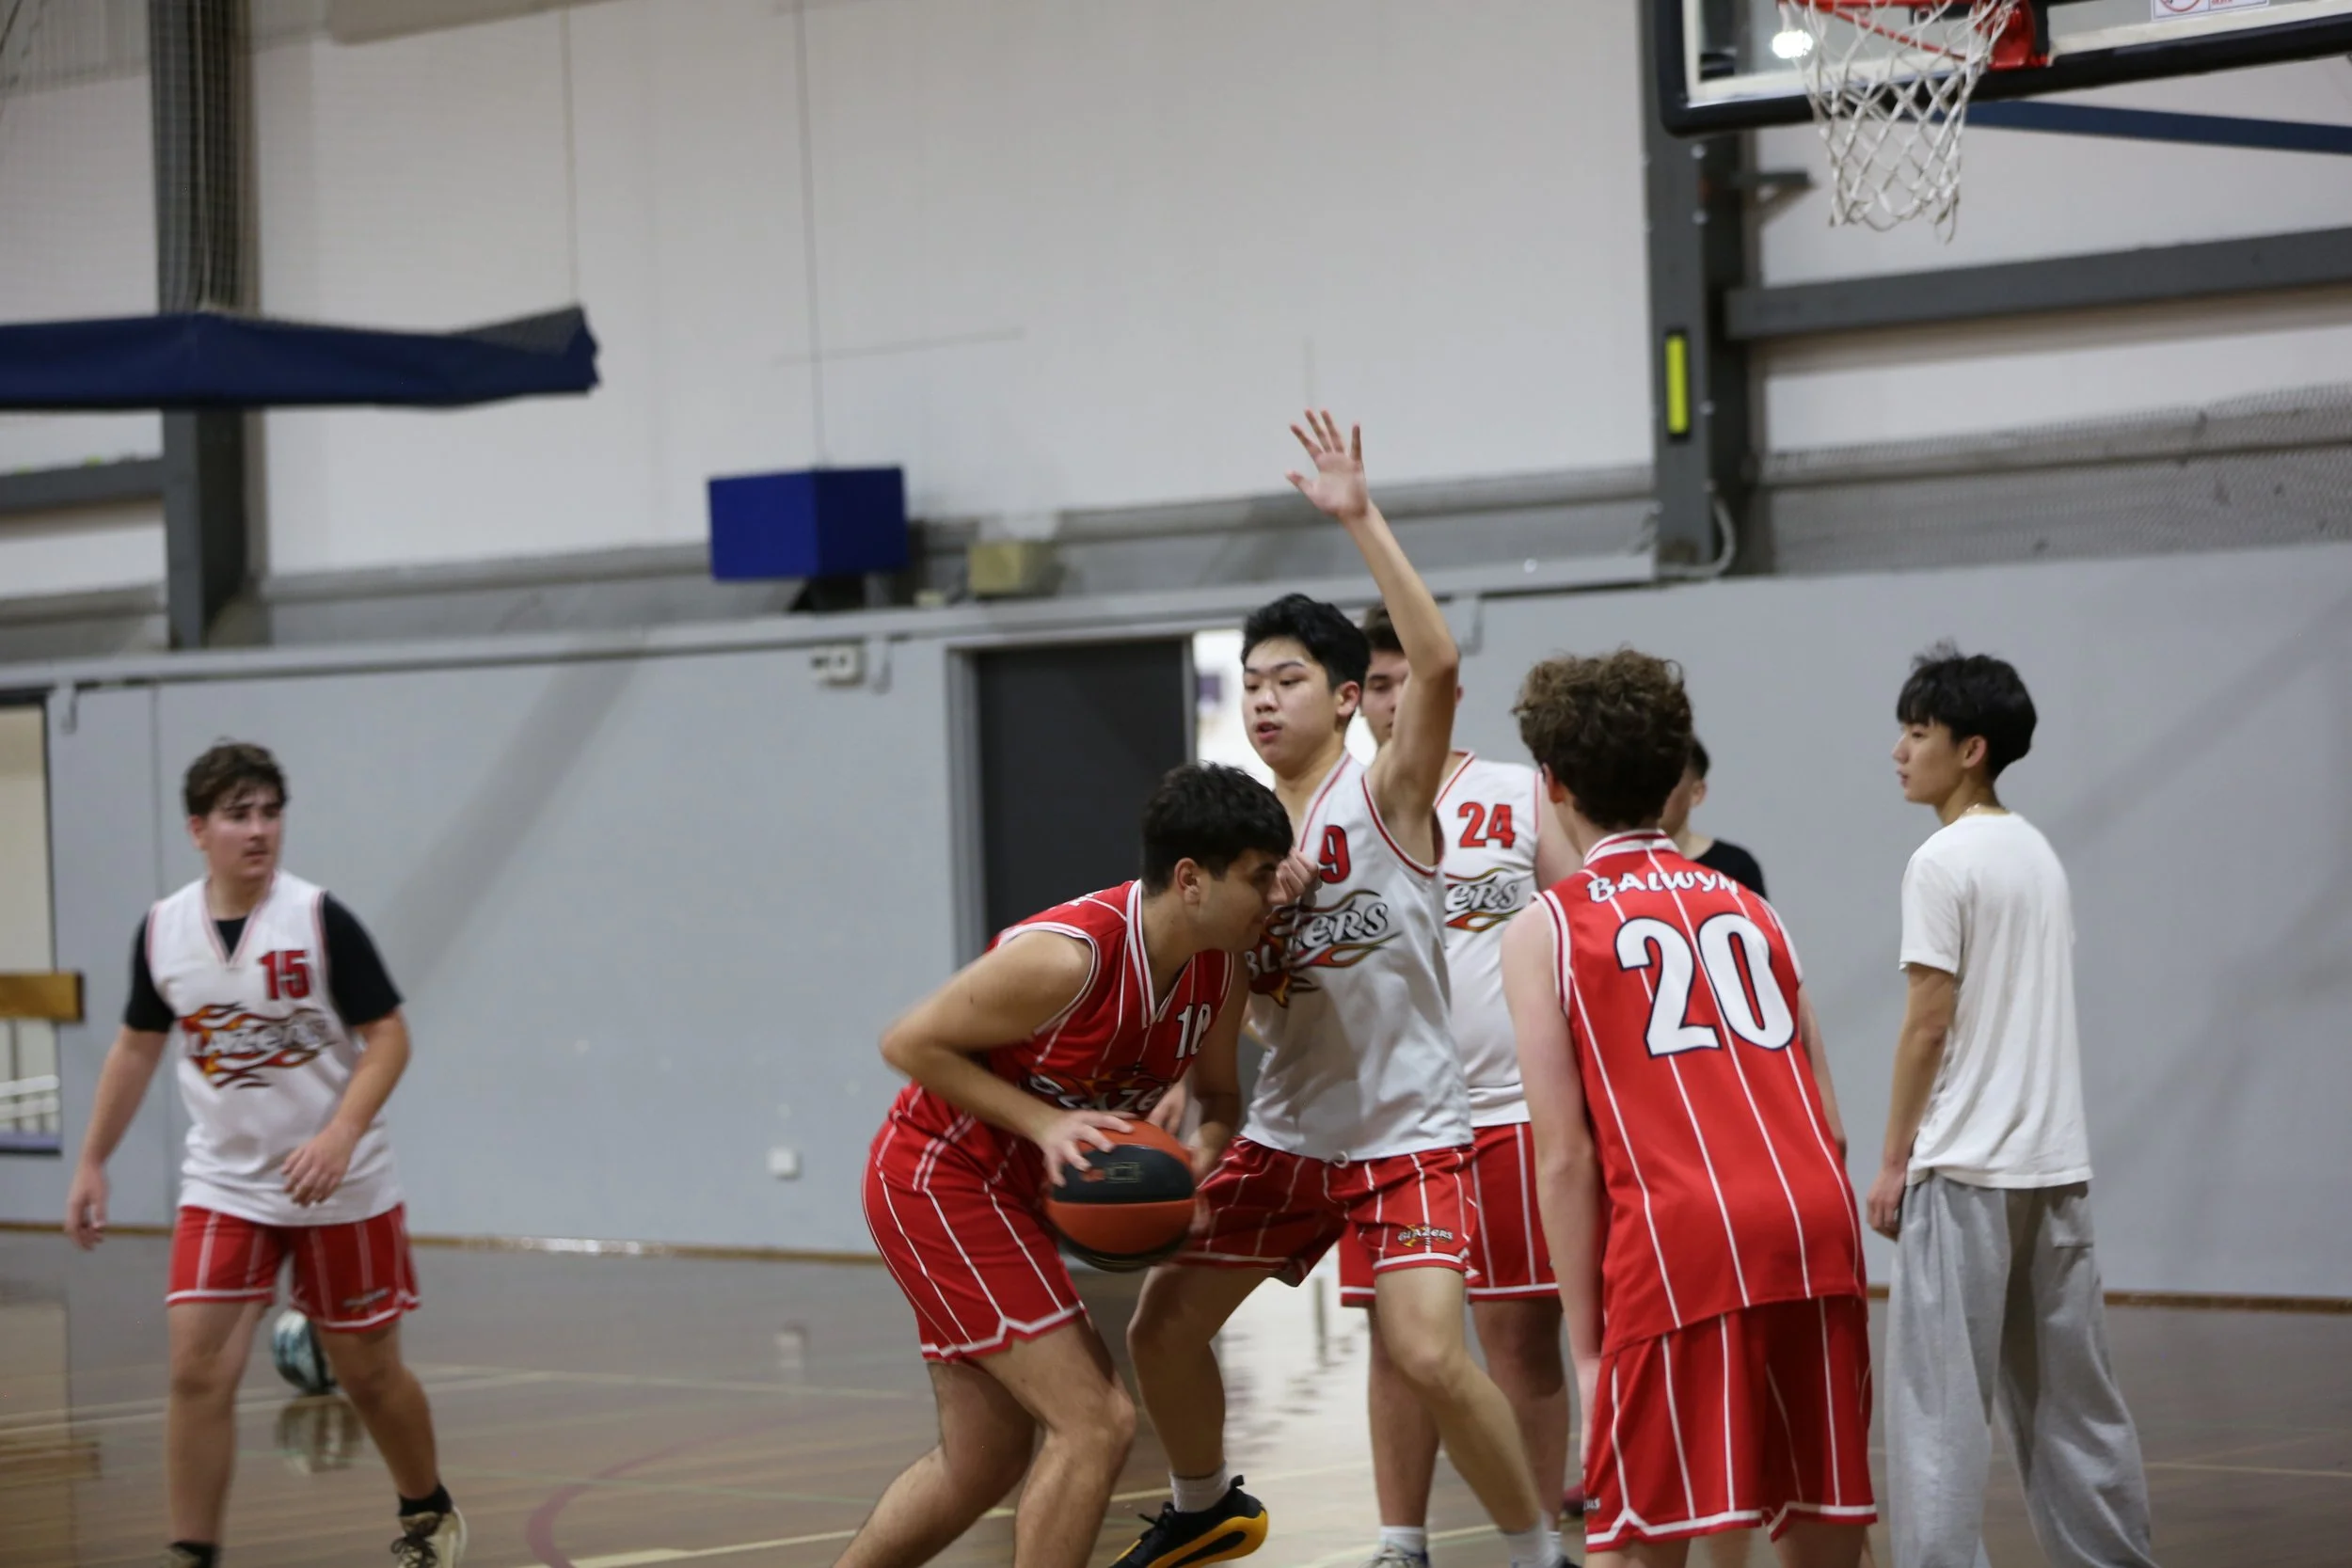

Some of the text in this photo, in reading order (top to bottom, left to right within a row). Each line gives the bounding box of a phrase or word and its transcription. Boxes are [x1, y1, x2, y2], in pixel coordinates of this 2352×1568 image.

[1456, 800, 1516, 849] 24
[1319, 824, 1351, 884] 9
[1586, 871, 1739, 903] BALWYN
[257, 950, 311, 1002] 15
[1614, 911, 1795, 1059] 20
